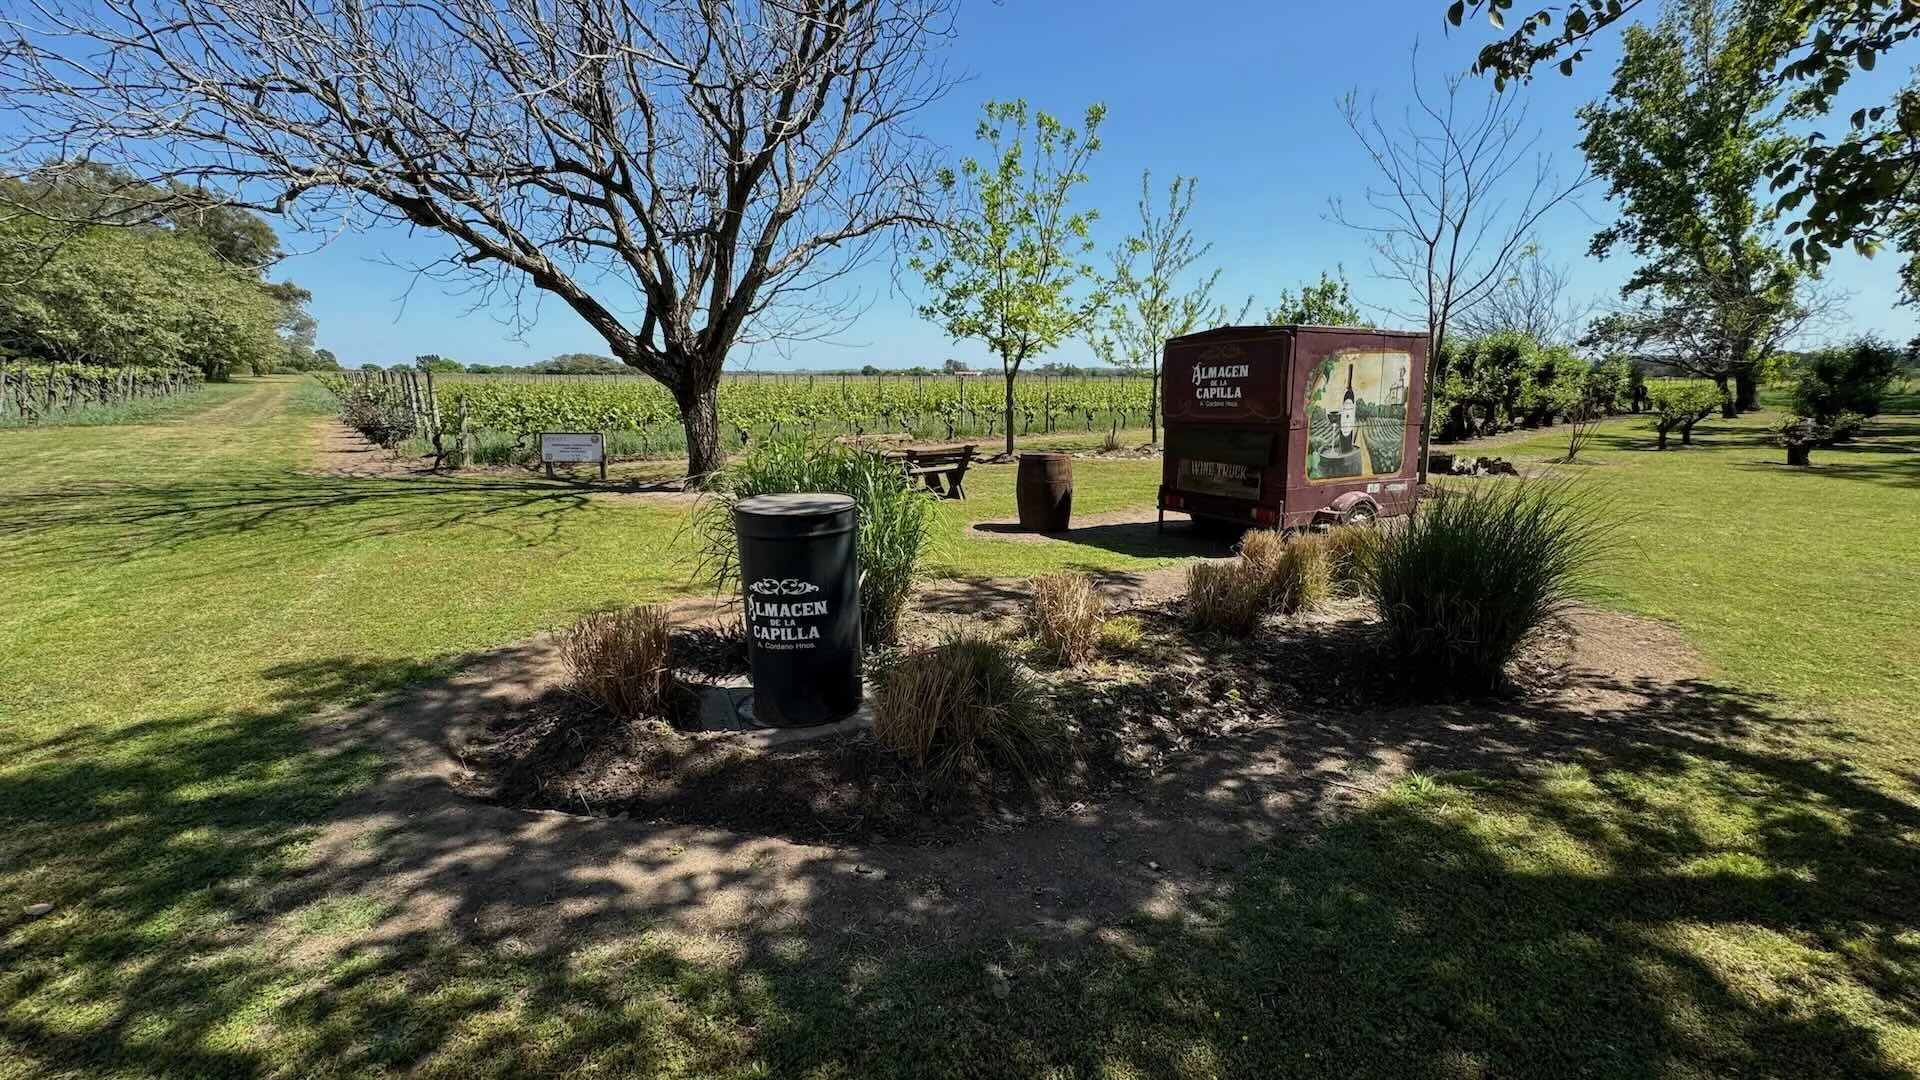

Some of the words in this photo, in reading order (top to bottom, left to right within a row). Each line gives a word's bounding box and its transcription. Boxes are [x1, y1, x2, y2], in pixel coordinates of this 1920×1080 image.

[1192, 362, 1249, 386] ALMACEN
[1196, 387, 1241, 399] CAPILLA
[1216, 463, 1247, 480] TRUCK
[747, 594, 828, 621] ALMACEN
[754, 625, 820, 640] CAPILLA
